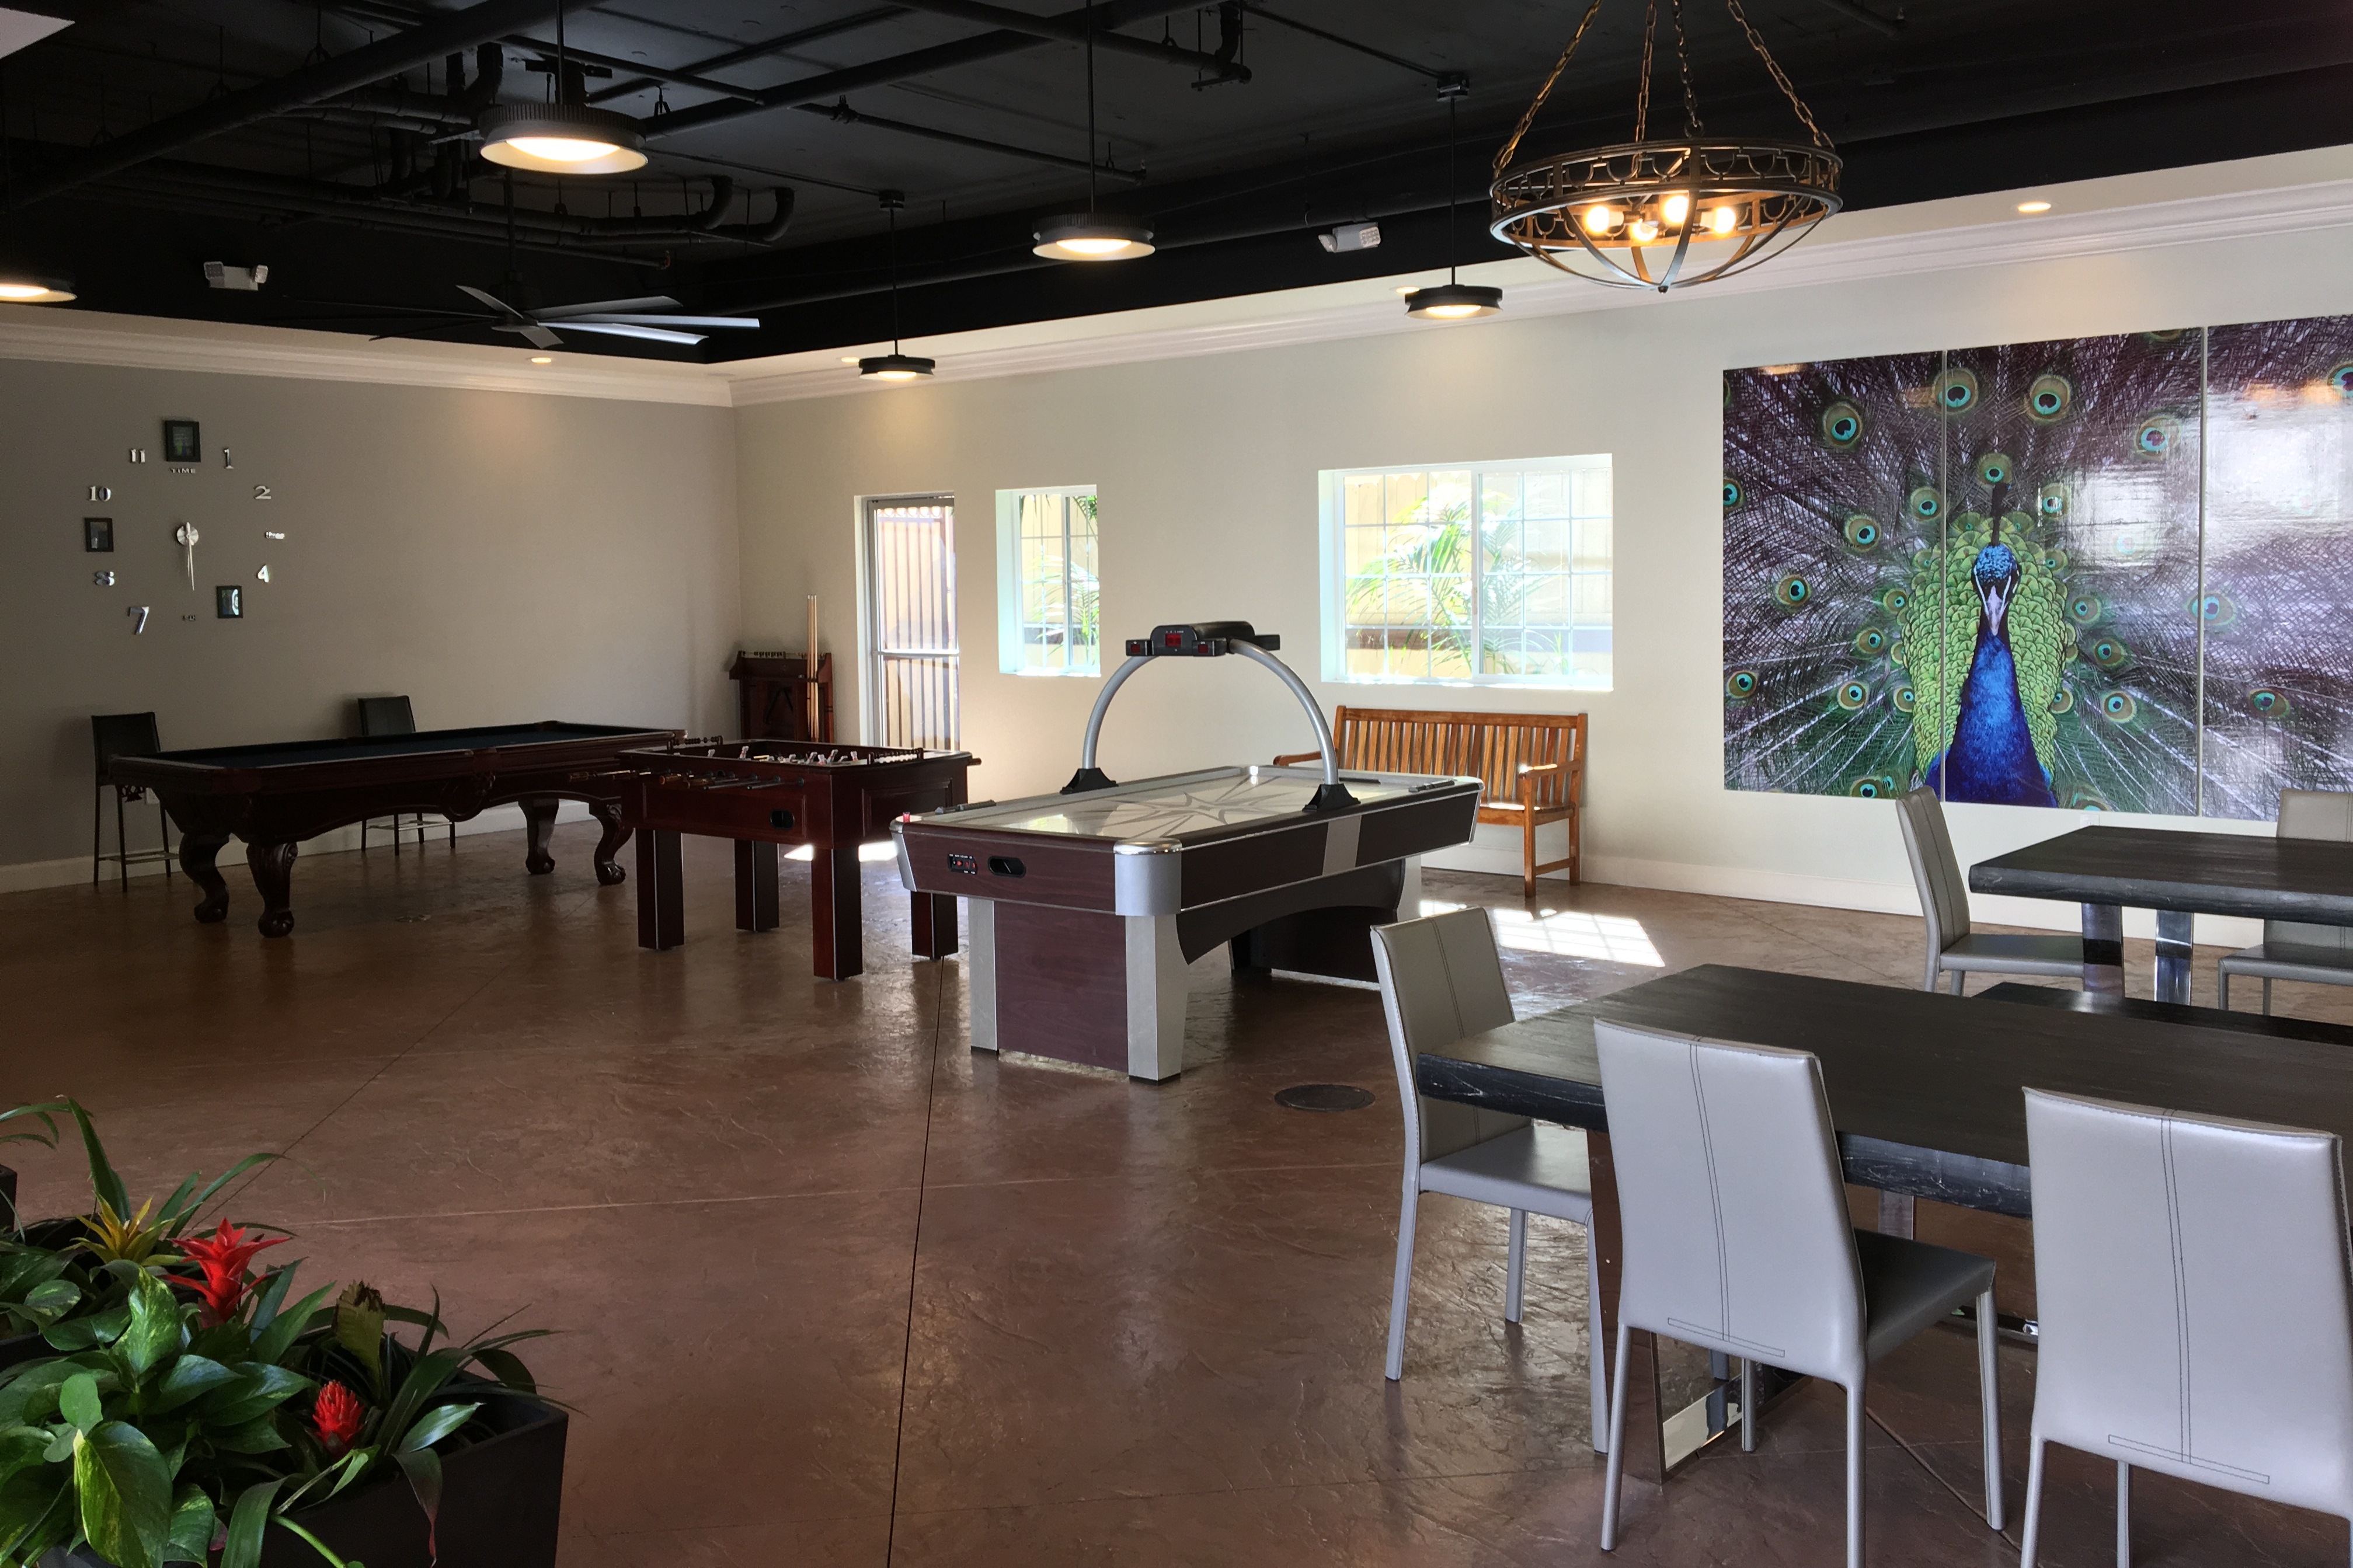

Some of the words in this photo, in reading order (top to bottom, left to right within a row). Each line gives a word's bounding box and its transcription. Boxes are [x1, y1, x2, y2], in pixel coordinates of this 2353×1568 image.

[130, 449, 145, 463] 11
[224, 449, 234, 469] 1
[89, 486, 111, 501] 10
[255, 486, 272, 500] 2
[257, 565, 269, 583] 4
[128, 606, 149, 635] 7
